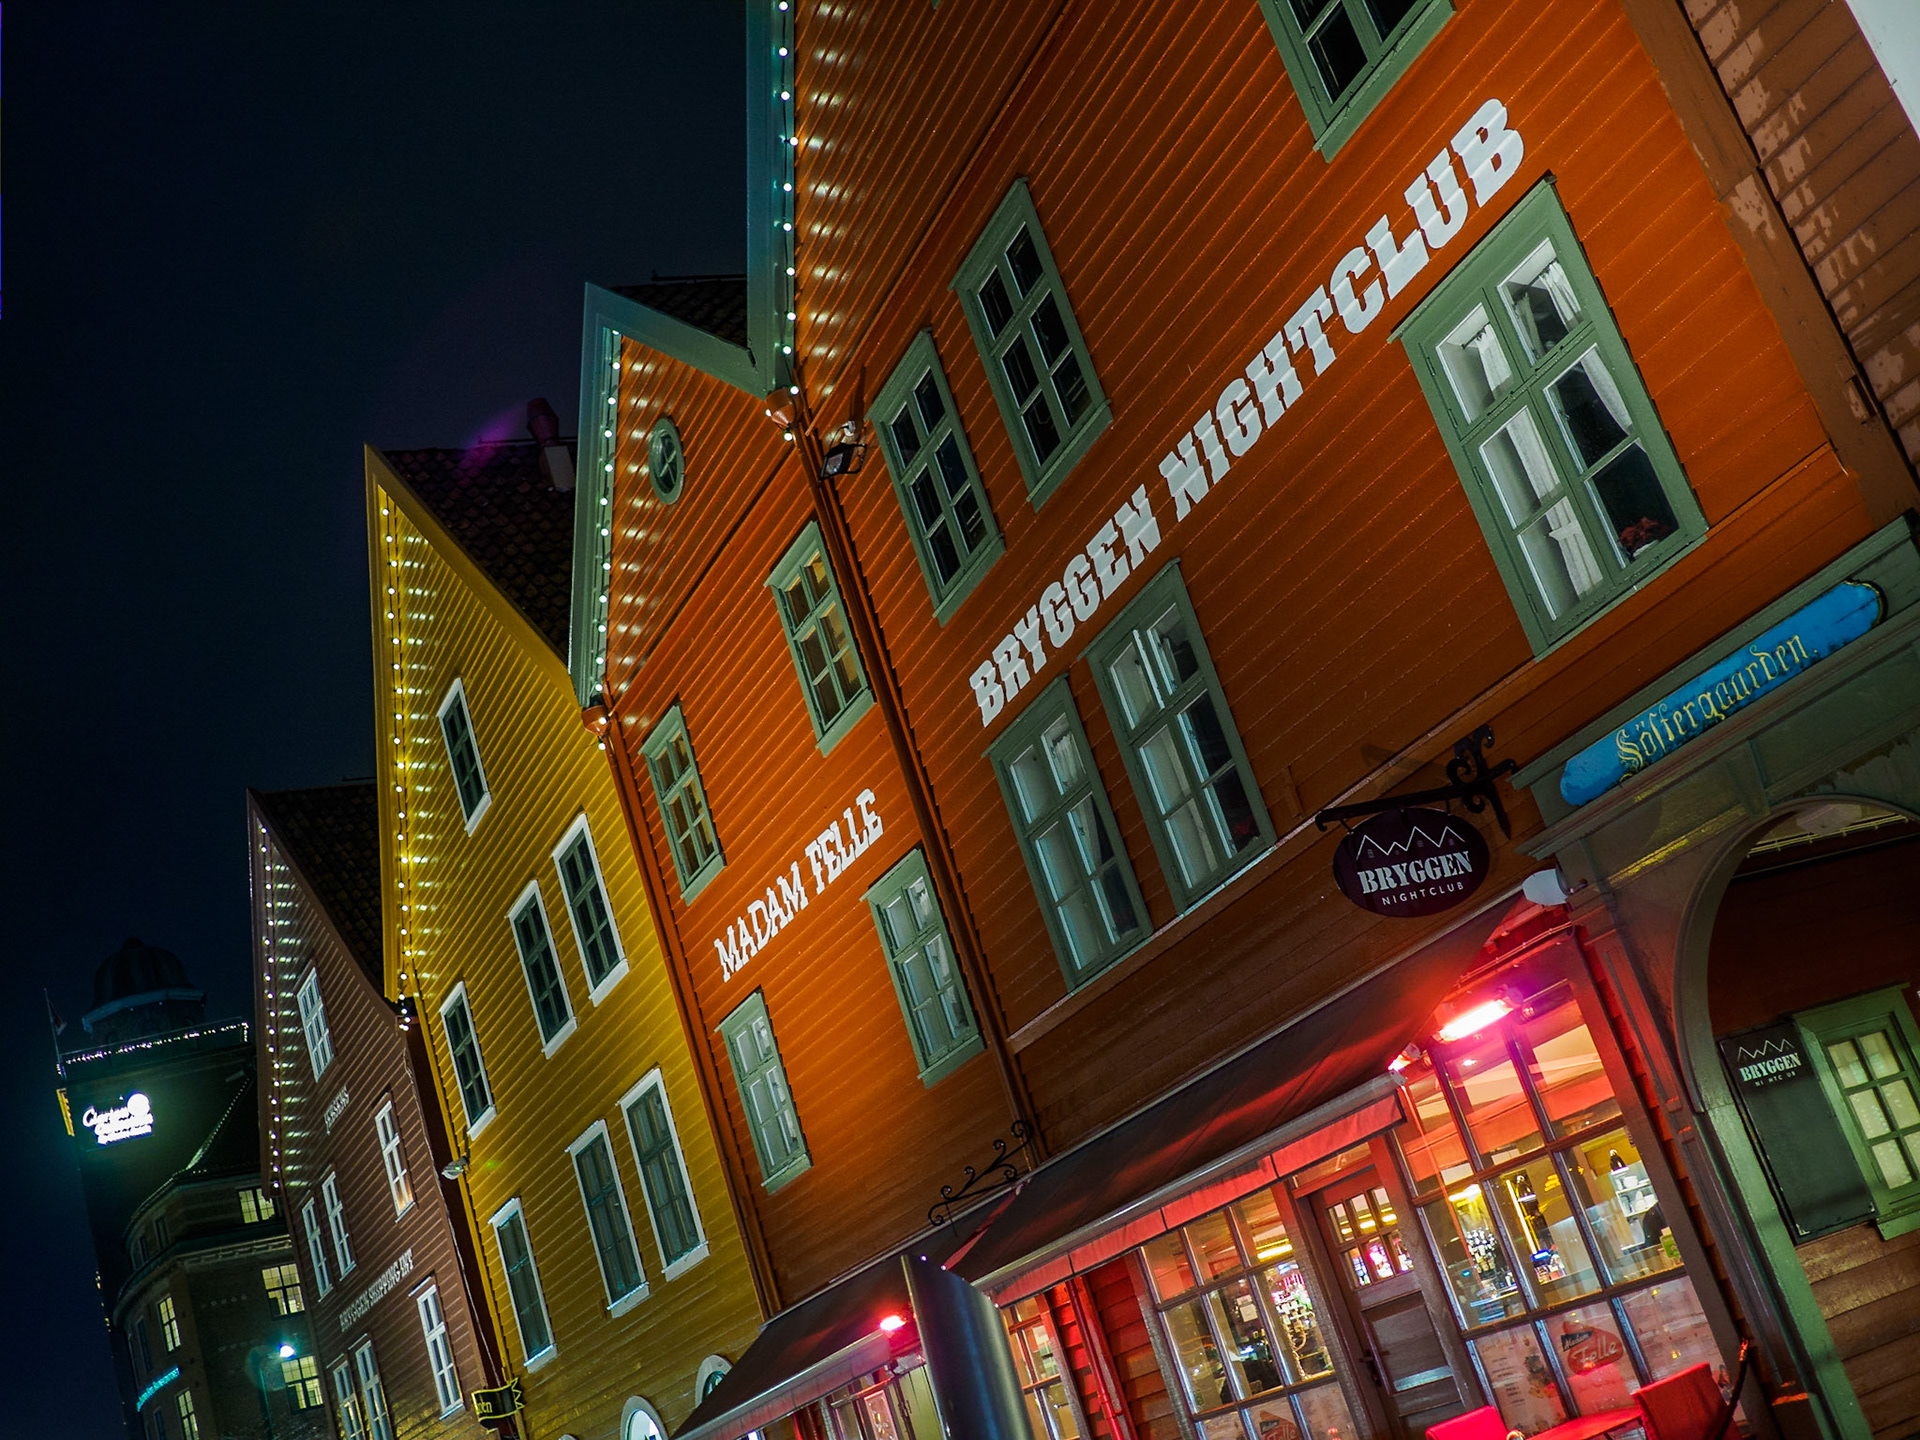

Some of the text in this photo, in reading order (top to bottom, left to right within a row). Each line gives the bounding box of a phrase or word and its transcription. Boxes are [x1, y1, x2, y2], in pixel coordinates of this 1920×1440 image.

[968, 98, 1525, 728] BRYGGEN NIGHTCLUB
[713, 788, 884, 983] MADAM FELLE
[1357, 850, 1473, 894] BRYGGEN
[1381, 881, 1464, 906] NIGHTCLUB
[1739, 1052, 1802, 1082] BRYGGEN
[1571, 1335, 1619, 1364] Felle
